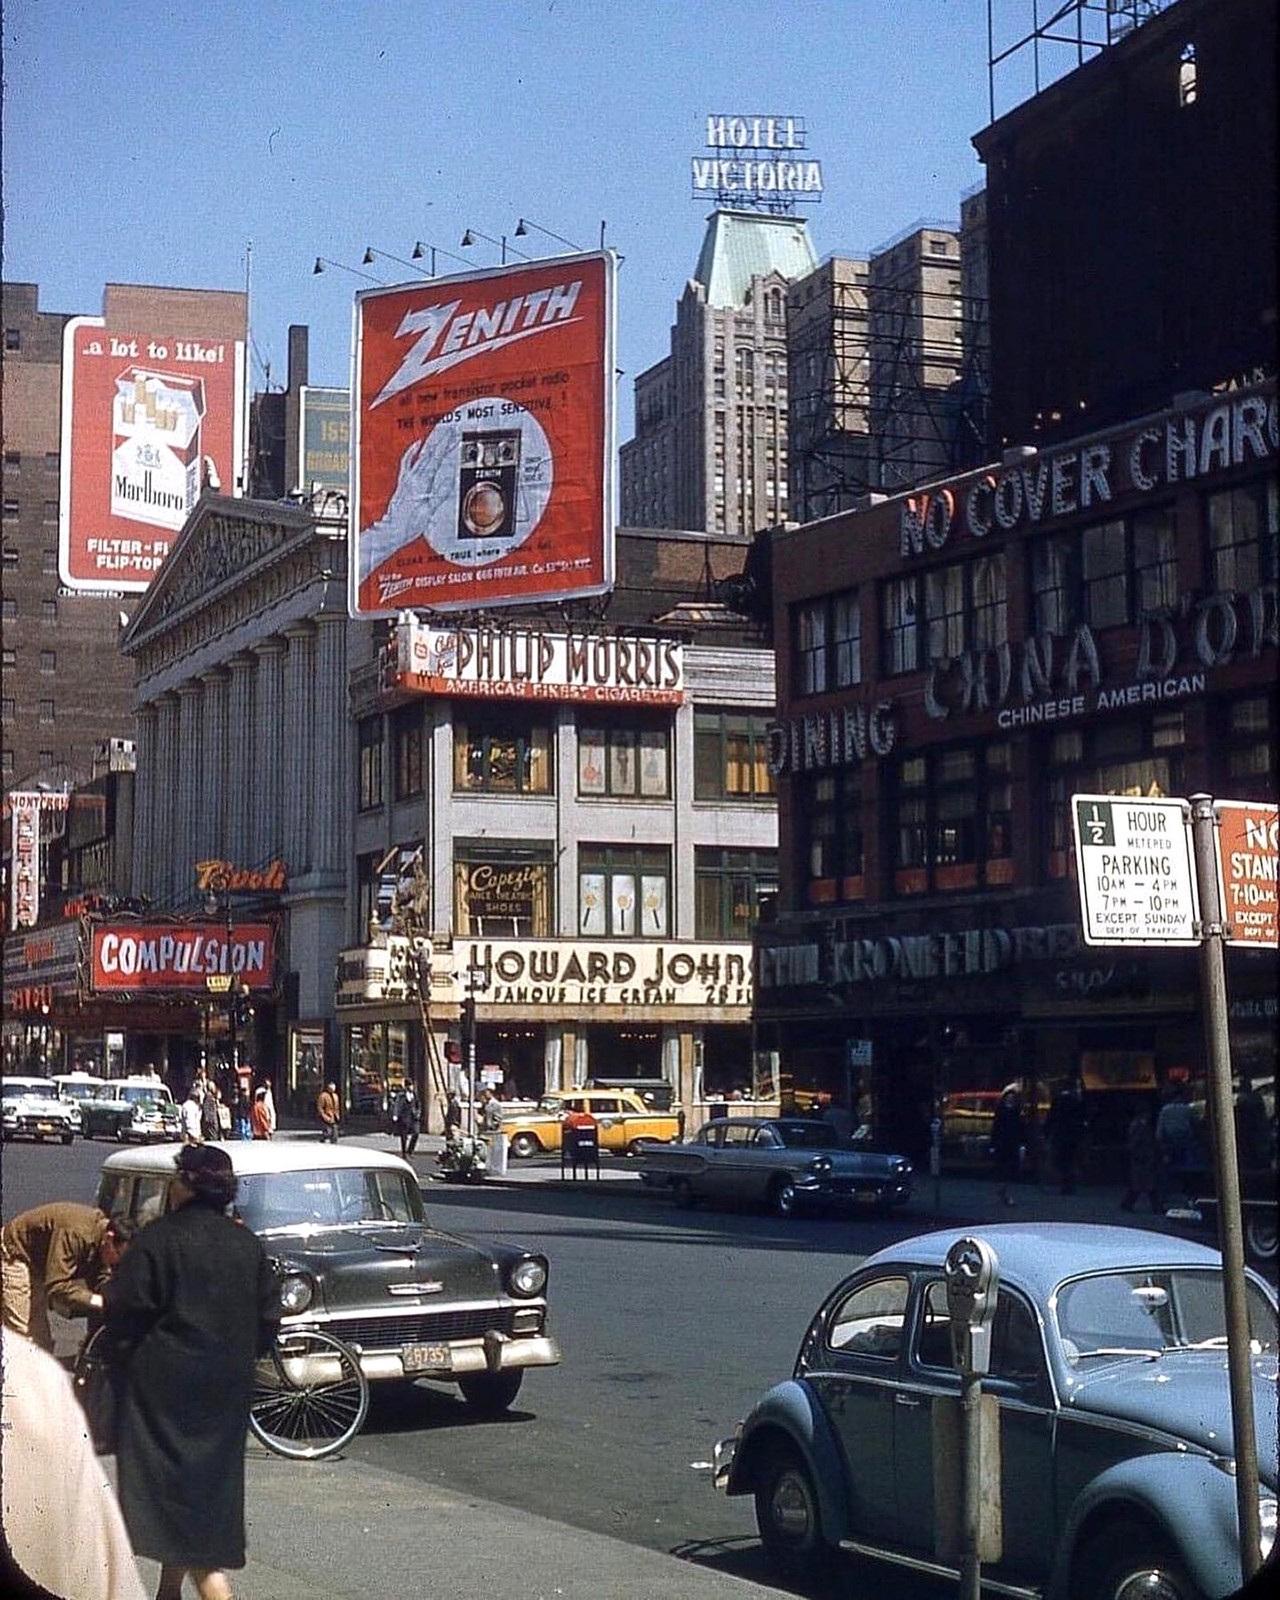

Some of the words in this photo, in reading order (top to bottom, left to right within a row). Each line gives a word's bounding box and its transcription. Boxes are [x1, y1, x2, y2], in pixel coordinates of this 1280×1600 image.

[706, 116, 804, 148] HOTEL
[692, 158, 822, 192] VICTORIA
[109, 338, 139, 358] lot
[147, 341, 168, 360] to
[175, 342, 225, 363] like!
[369, 281, 584, 411] ZENITH
[443, 382, 496, 400] transistor
[501, 376, 536, 394] pocket
[541, 371, 571, 386] radio
[397, 417, 414, 430] THE
[467, 405, 494, 420] MOST
[114, 469, 184, 512] Marlboro
[900, 487, 956, 557] NO
[966, 444, 1112, 538] COVER
[86, 538, 142, 555] FILTER
[450, 551, 472, 561] TRUE
[96, 554, 163, 572] FLIP-TOP
[414, 574, 446, 588] DISPLAY
[447, 571, 474, 585] SALON
[456, 628, 554, 682] PHILIP
[565, 632, 682, 688] MORRIS
[923, 622, 1101, 721] CHINA
[532, 683, 589, 699] FINEST
[998, 697, 1085, 728] CHINESE
[1096, 674, 1206, 710] AMERICAN
[767, 700, 896, 774] DINING
[1127, 811, 1167, 833] HOUR
[1127, 838, 1172, 850] METERED
[1102, 854, 1171, 876] PARKING
[1231, 852, 1278, 881] STAN
[470, 864, 540, 895] Capezio
[485, 902, 522, 913] SHOES
[1096, 913, 1137, 924] EXCEPT
[1144, 913, 1187, 925] SUNDAY
[1235, 910, 1273, 925] EXCEPT
[1146, 927, 1179, 935] TRAFFIC
[101, 933, 265, 975] COMPULSION
[471, 944, 637, 987] HOWARD
[644, 947, 753, 988] JOHN
[494, 985, 567, 1004] FAMOUS
[580, 987, 607, 1004] ICE
[620, 987, 677, 1004] CREAM
[705, 984, 728, 1004] 28
